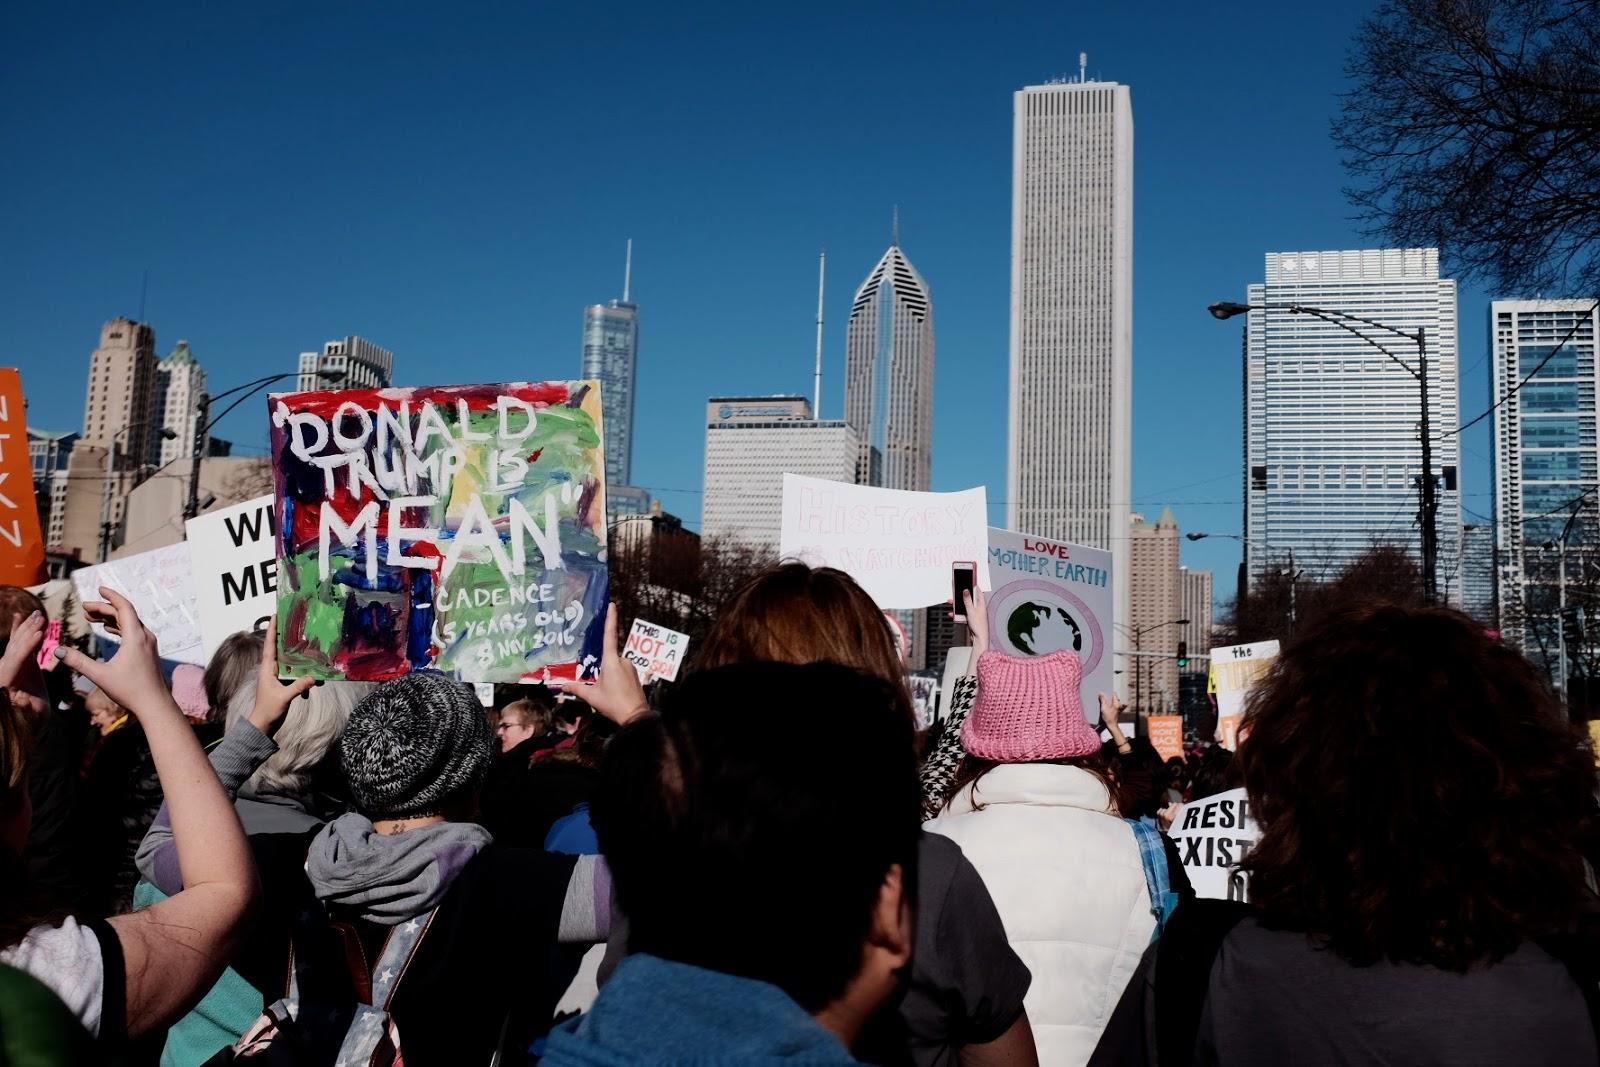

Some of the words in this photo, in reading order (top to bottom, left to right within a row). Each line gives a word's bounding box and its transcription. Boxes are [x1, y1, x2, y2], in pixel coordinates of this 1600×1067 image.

[310, 446, 466, 500] TRUMP
[485, 448, 529, 494] IS
[799, 486, 975, 536] HISTORY
[1024, 538, 1069, 559] LOVE
[988, 546, 1050, 576] MOTHER
[1056, 560, 1107, 587] EARTH
[436, 583, 555, 612] CADENCE
[535, 600, 584, 632] OLD)
[532, 629, 575, 649] 2016
[635, 622, 660, 639] THIS
[665, 633, 678, 645] IS
[627, 634, 664, 657] NOT
[665, 649, 676, 662] A
[1232, 647, 1253, 658] the
